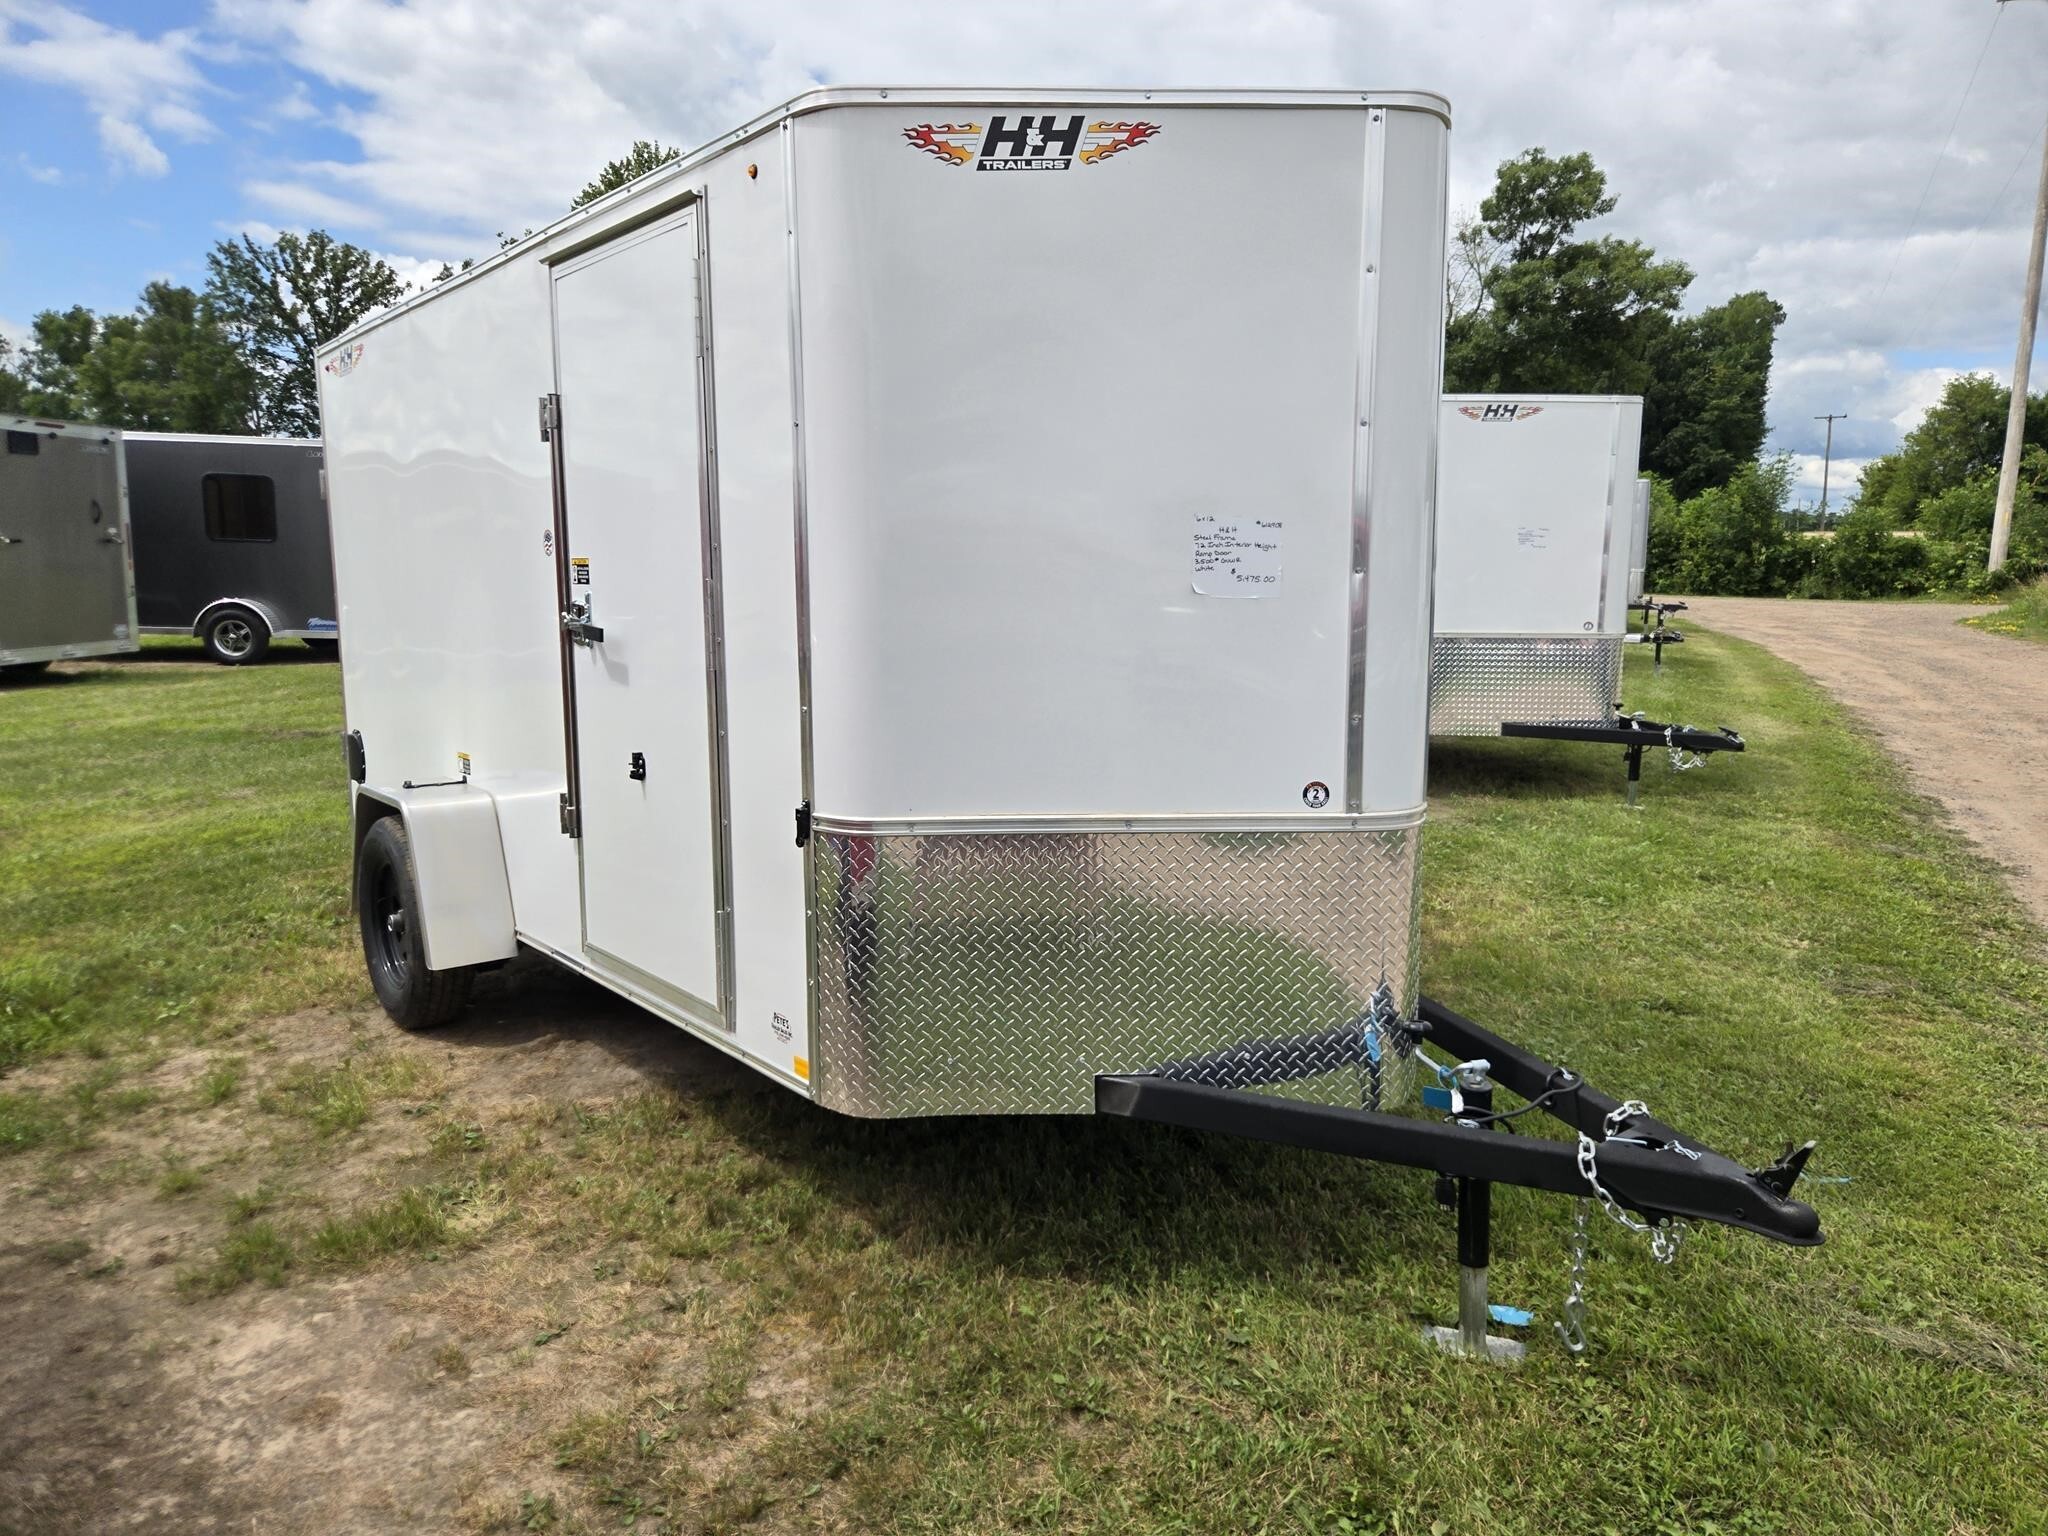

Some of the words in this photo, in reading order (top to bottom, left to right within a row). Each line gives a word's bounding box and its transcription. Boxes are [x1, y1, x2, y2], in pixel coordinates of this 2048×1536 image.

[980, 115, 1086, 157] H&H
[983, 160, 1065, 170] TRAILERS
[1213, 533, 1236, 541] Frame
